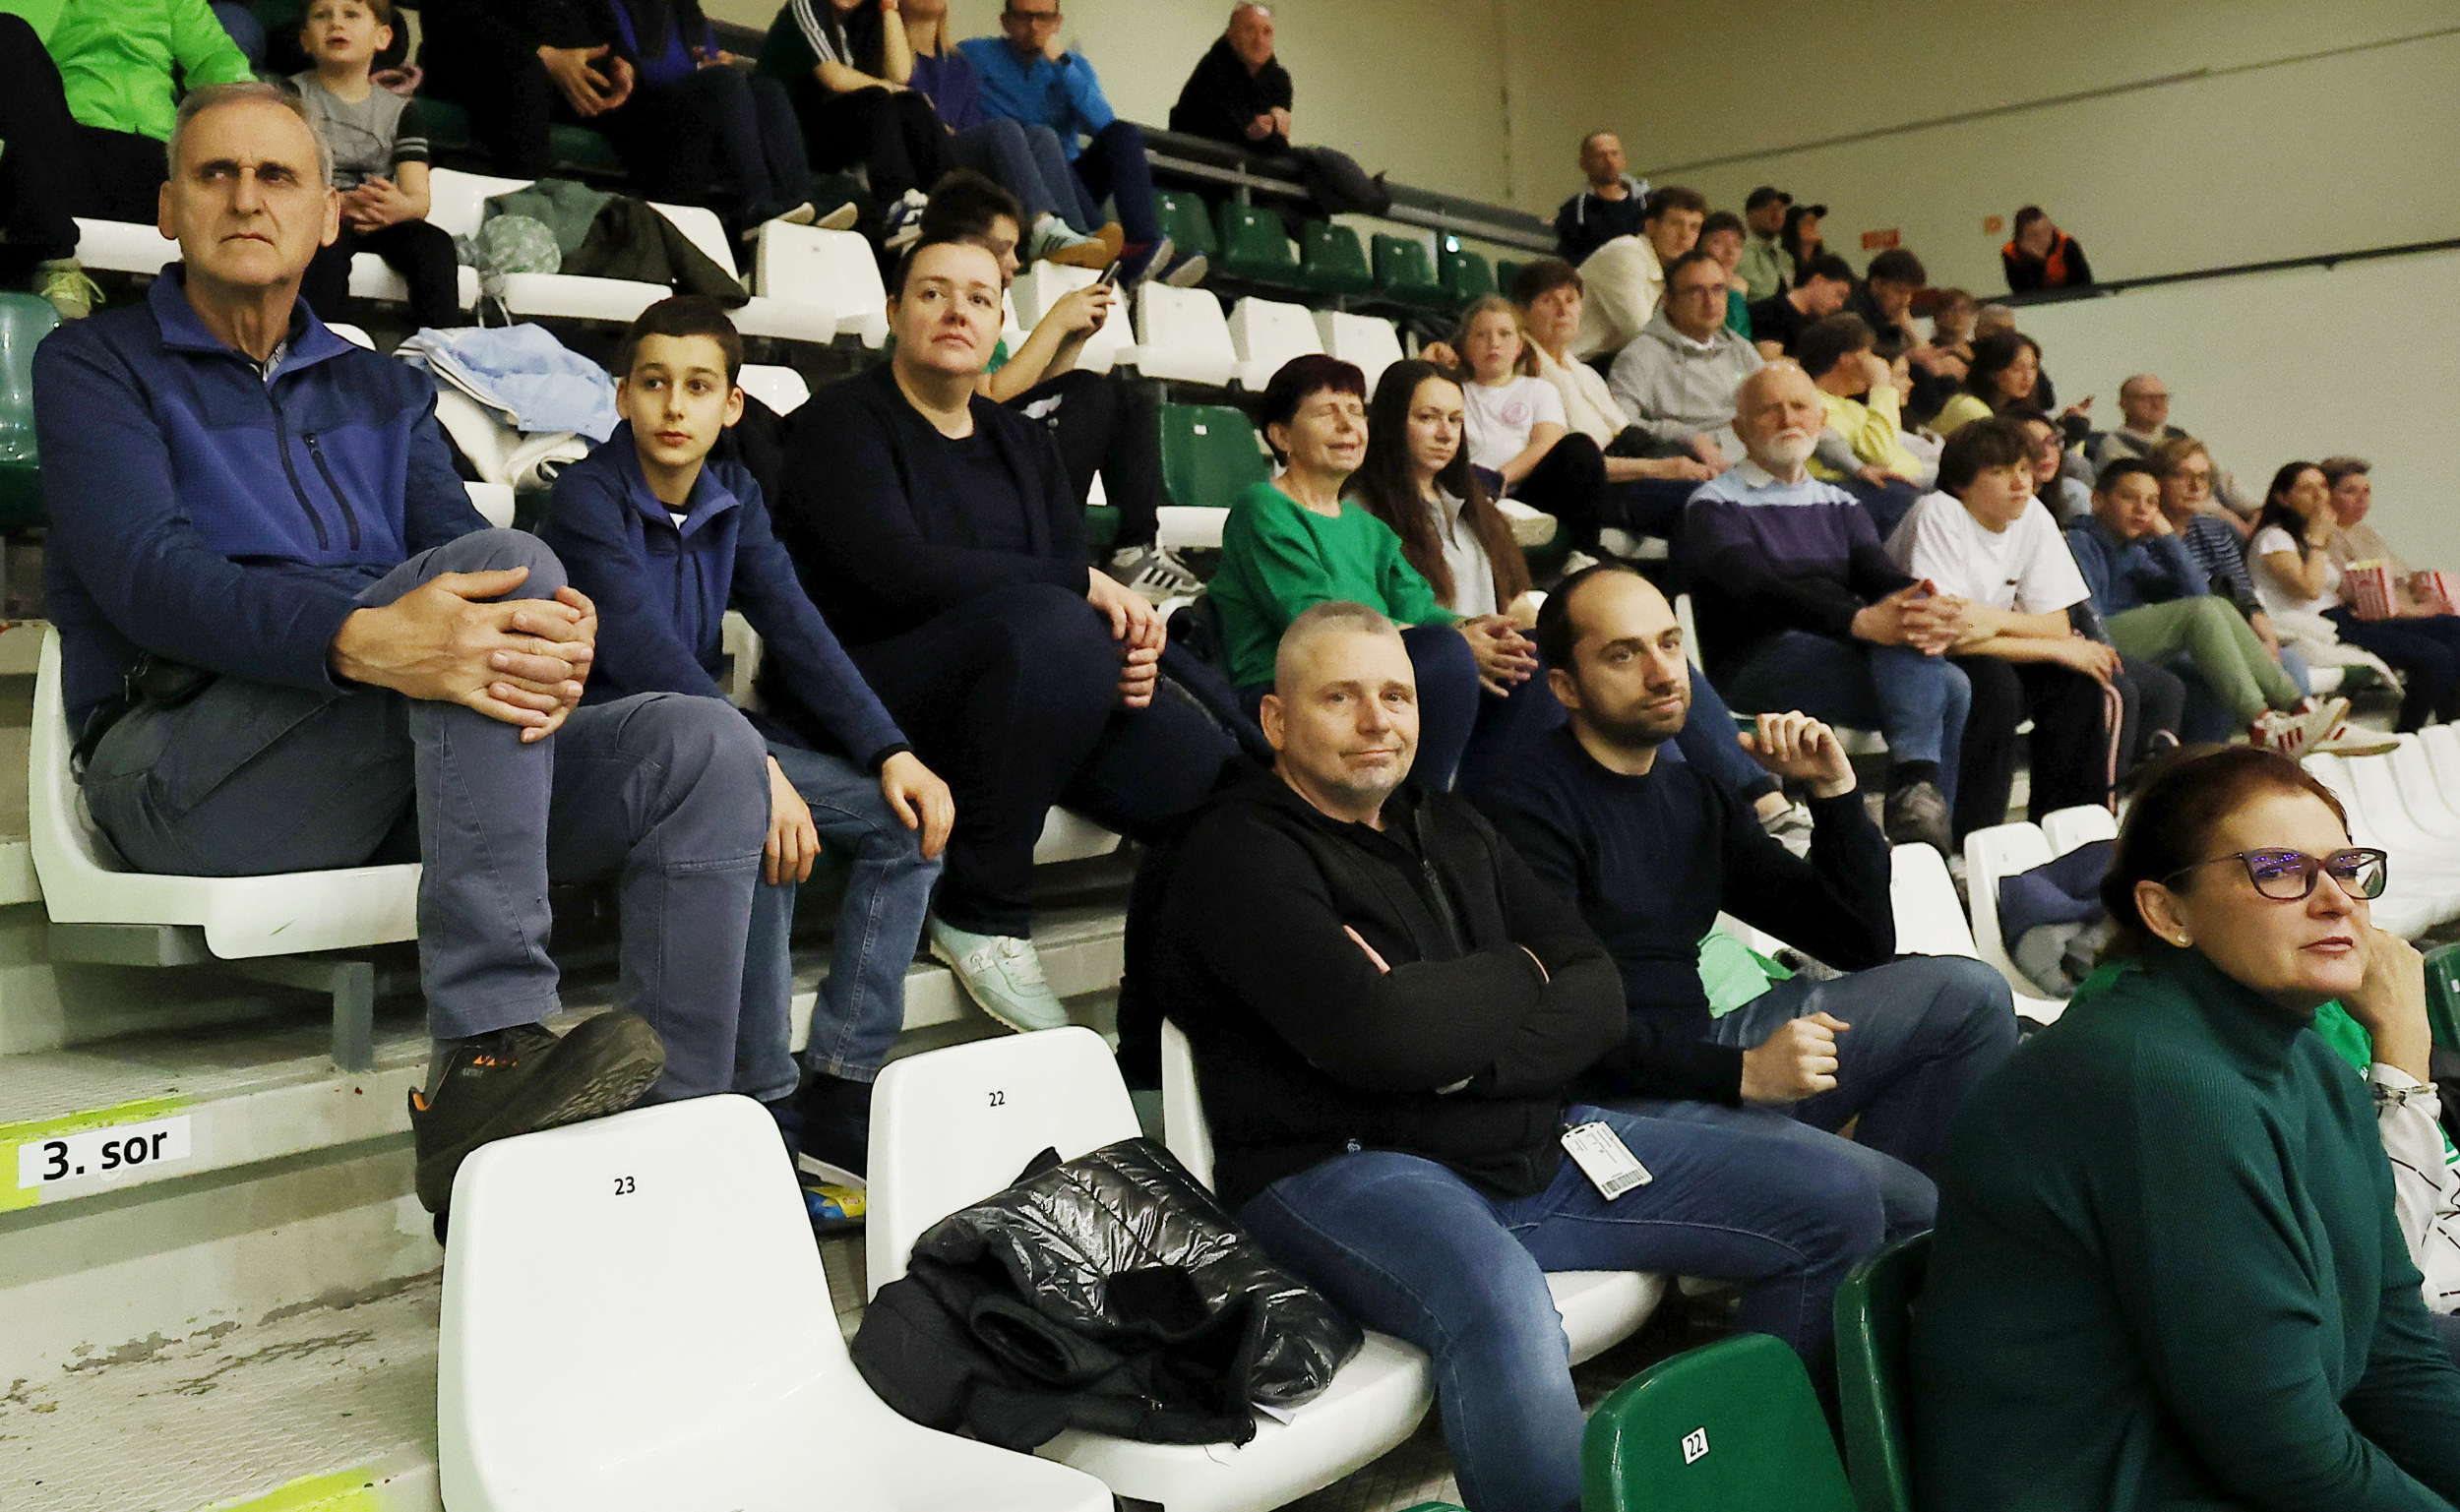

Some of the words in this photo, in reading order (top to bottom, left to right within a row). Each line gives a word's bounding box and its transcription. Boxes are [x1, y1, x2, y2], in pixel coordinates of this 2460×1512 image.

[988, 1090, 1006, 1108] 22
[43, 1141, 85, 1180] 3.
[101, 1131, 167, 1170] sor
[614, 1176, 636, 1196] 23
[1687, 1432, 1703, 1458] 22
